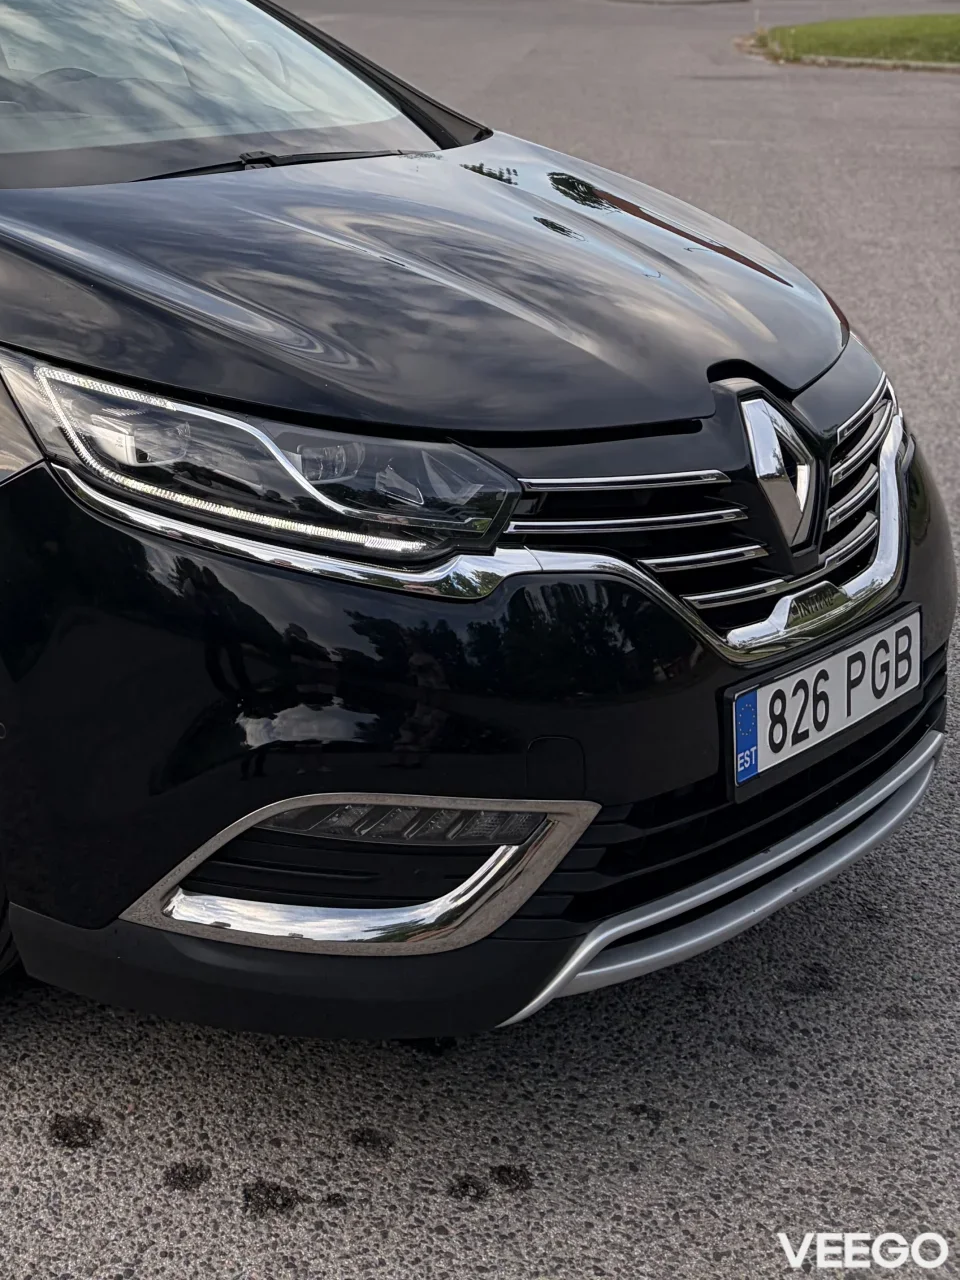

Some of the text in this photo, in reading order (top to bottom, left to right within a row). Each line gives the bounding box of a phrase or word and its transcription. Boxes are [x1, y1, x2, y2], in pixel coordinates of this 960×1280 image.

[768, 625, 912, 753] 826 PGB
[737, 746, 757, 772] EST
